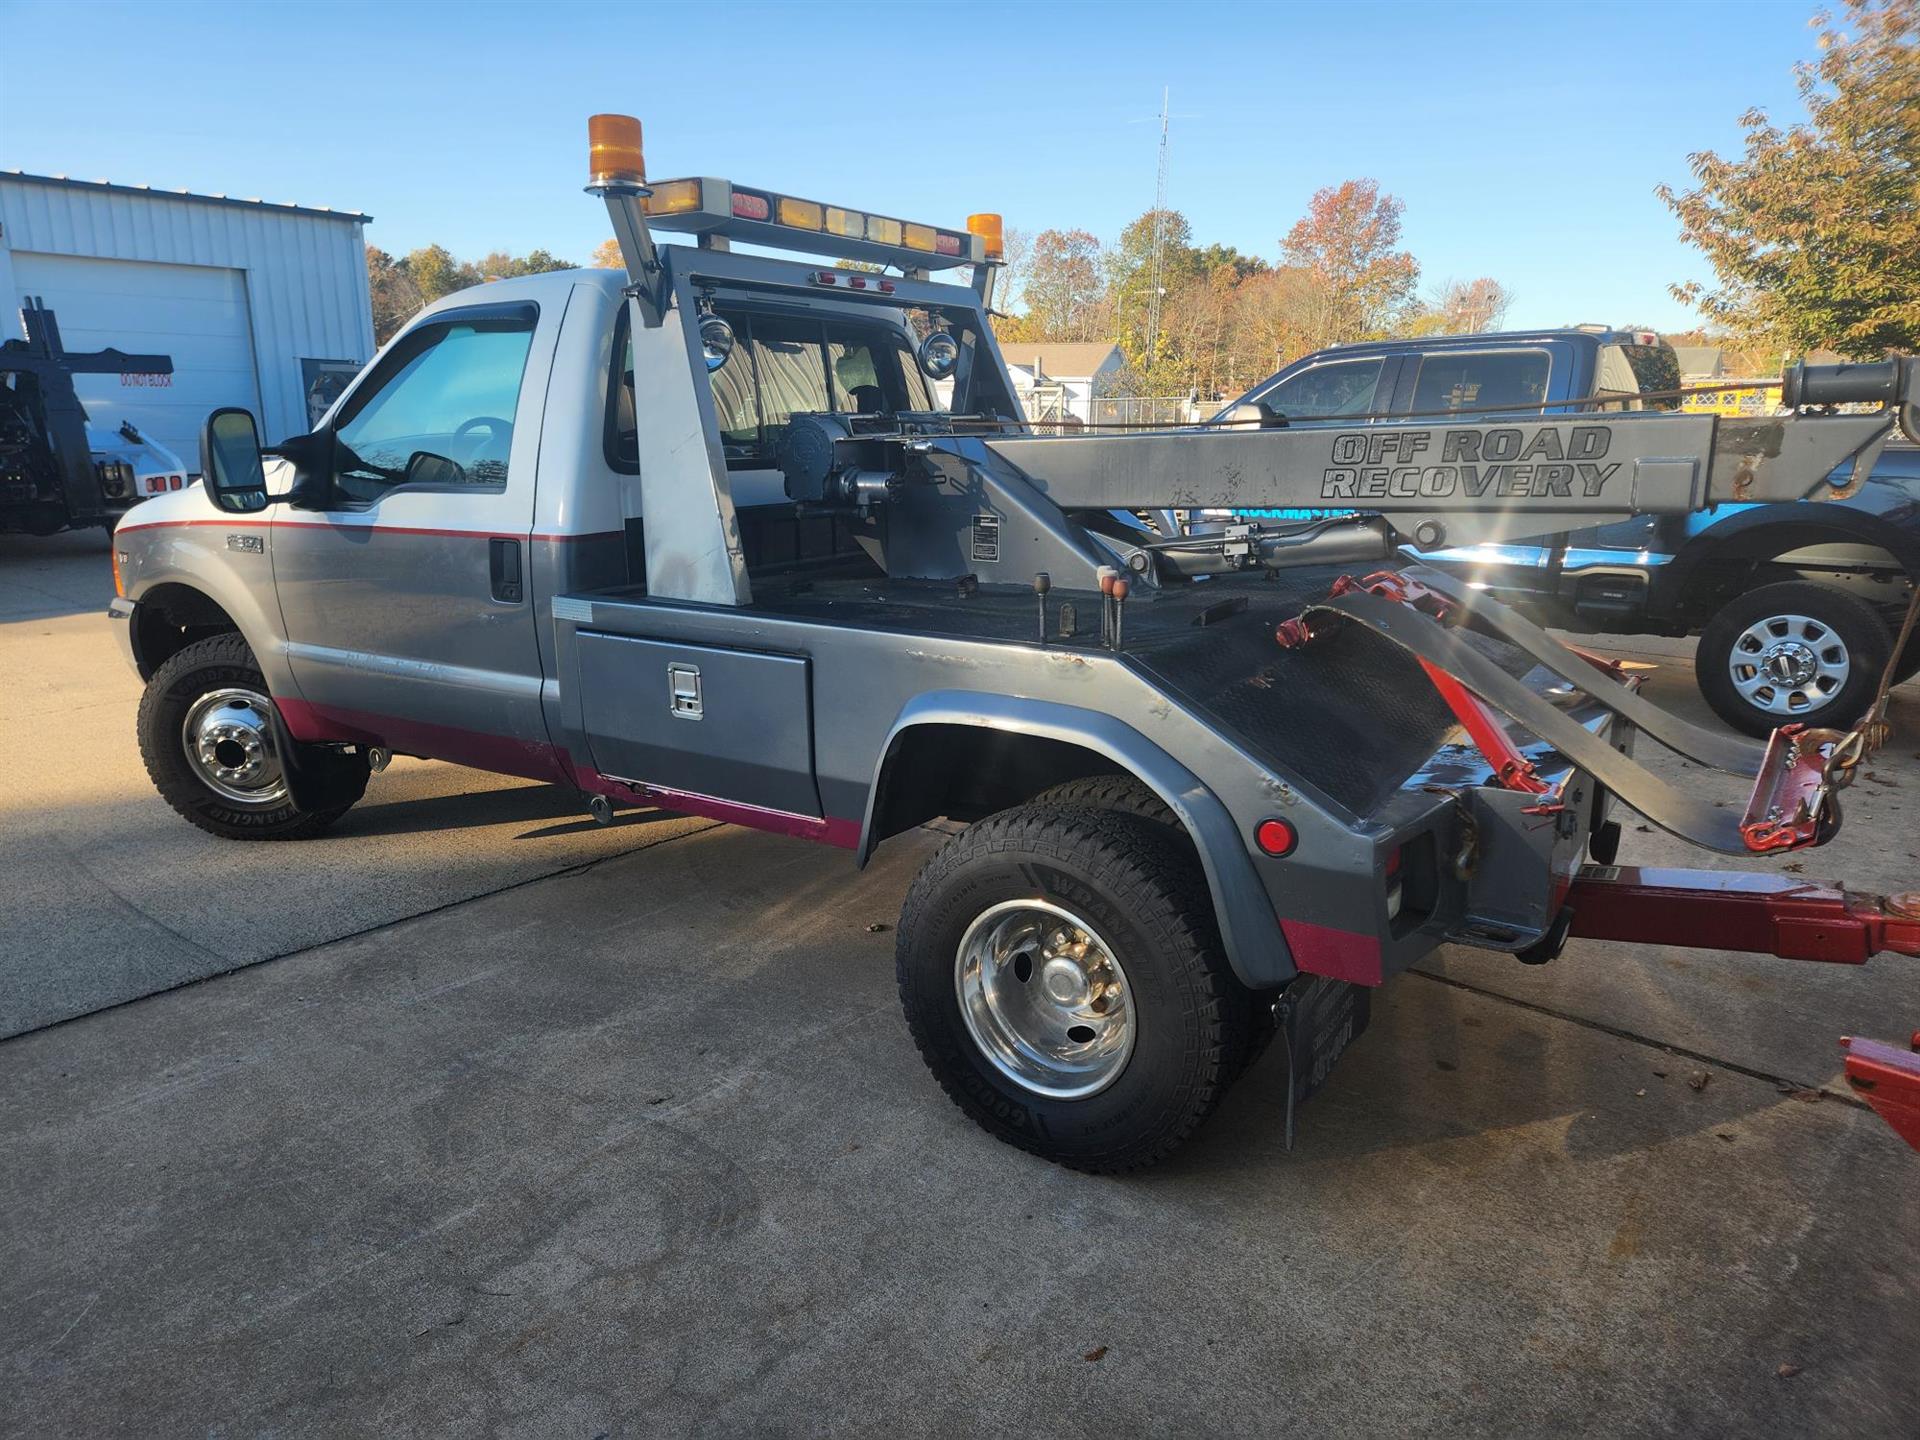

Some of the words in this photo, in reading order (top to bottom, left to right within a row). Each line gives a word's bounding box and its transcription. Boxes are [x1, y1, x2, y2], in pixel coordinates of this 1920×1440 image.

[1331, 431, 1431, 465] OFF
[1441, 426, 1612, 463] ROAD
[1320, 462, 1623, 498] RECOVERY
